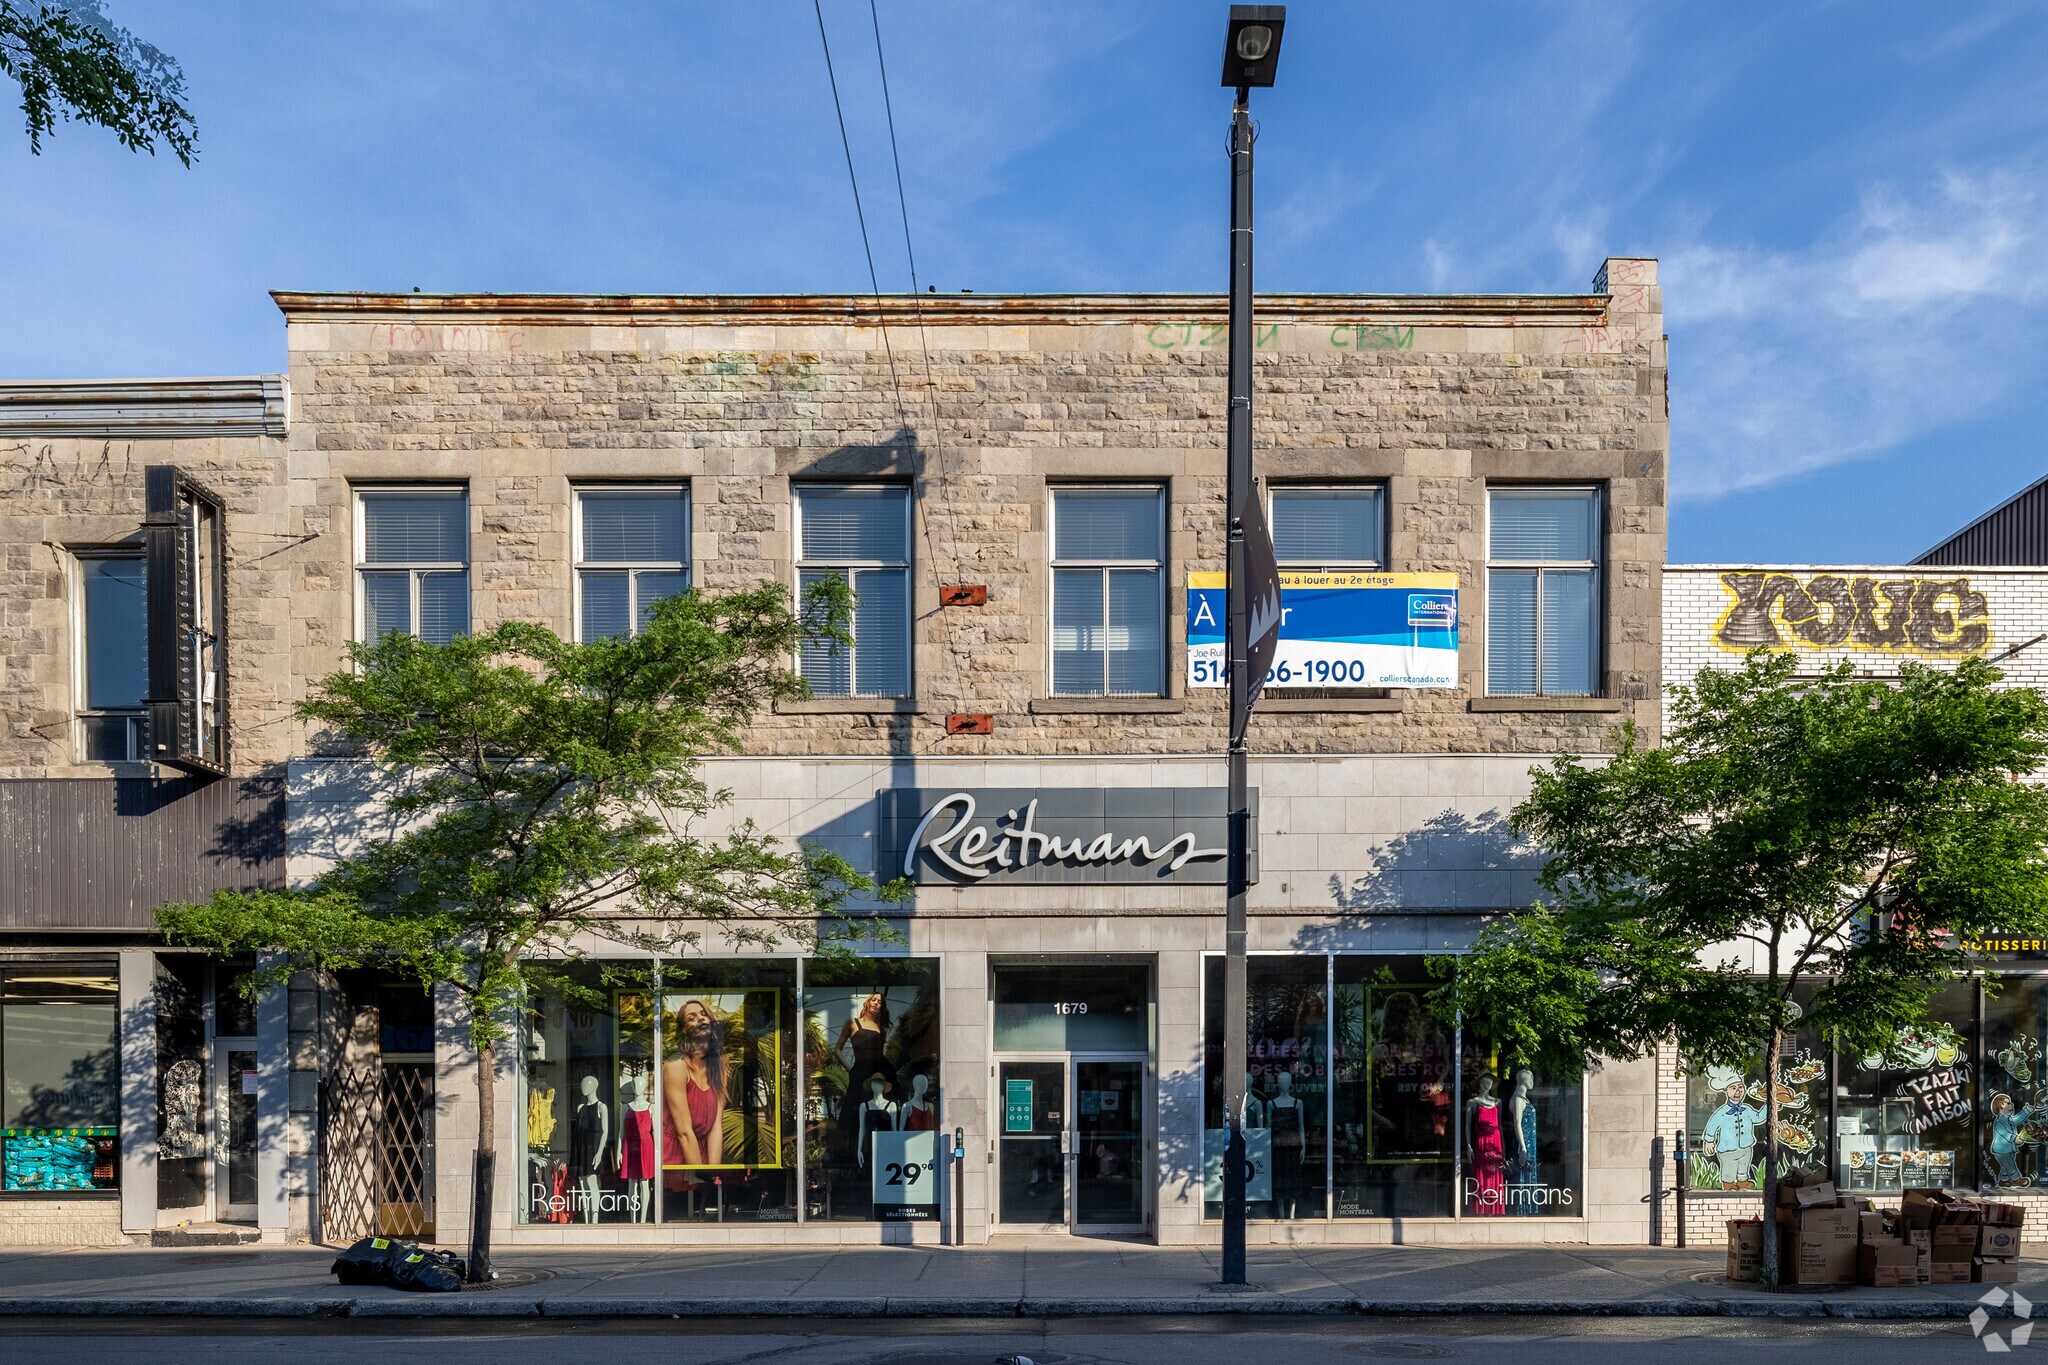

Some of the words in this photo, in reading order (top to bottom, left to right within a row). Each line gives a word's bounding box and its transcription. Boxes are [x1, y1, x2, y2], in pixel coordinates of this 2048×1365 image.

[1294, 575, 1301, 584] à
[1303, 575, 1331, 584] louer
[1333, 577, 1346, 585] au
[1350, 575, 1362, 584] 2e
[1366, 574, 1395, 586] étage
[1193, 594, 1216, 627] À
[1413, 599, 1449, 610] Colliers
[904, 792, 1227, 877] Reitmans
[1053, 1002, 1088, 1015] 1679
[1906, 1068, 1970, 1094] TZAZIKI
[1923, 1085, 1960, 1111] FAIT
[1915, 1098, 1973, 1134] MAISON
[531, 1183, 641, 1212] Reitmans
[1464, 1177, 1573, 1206] Reitmans
